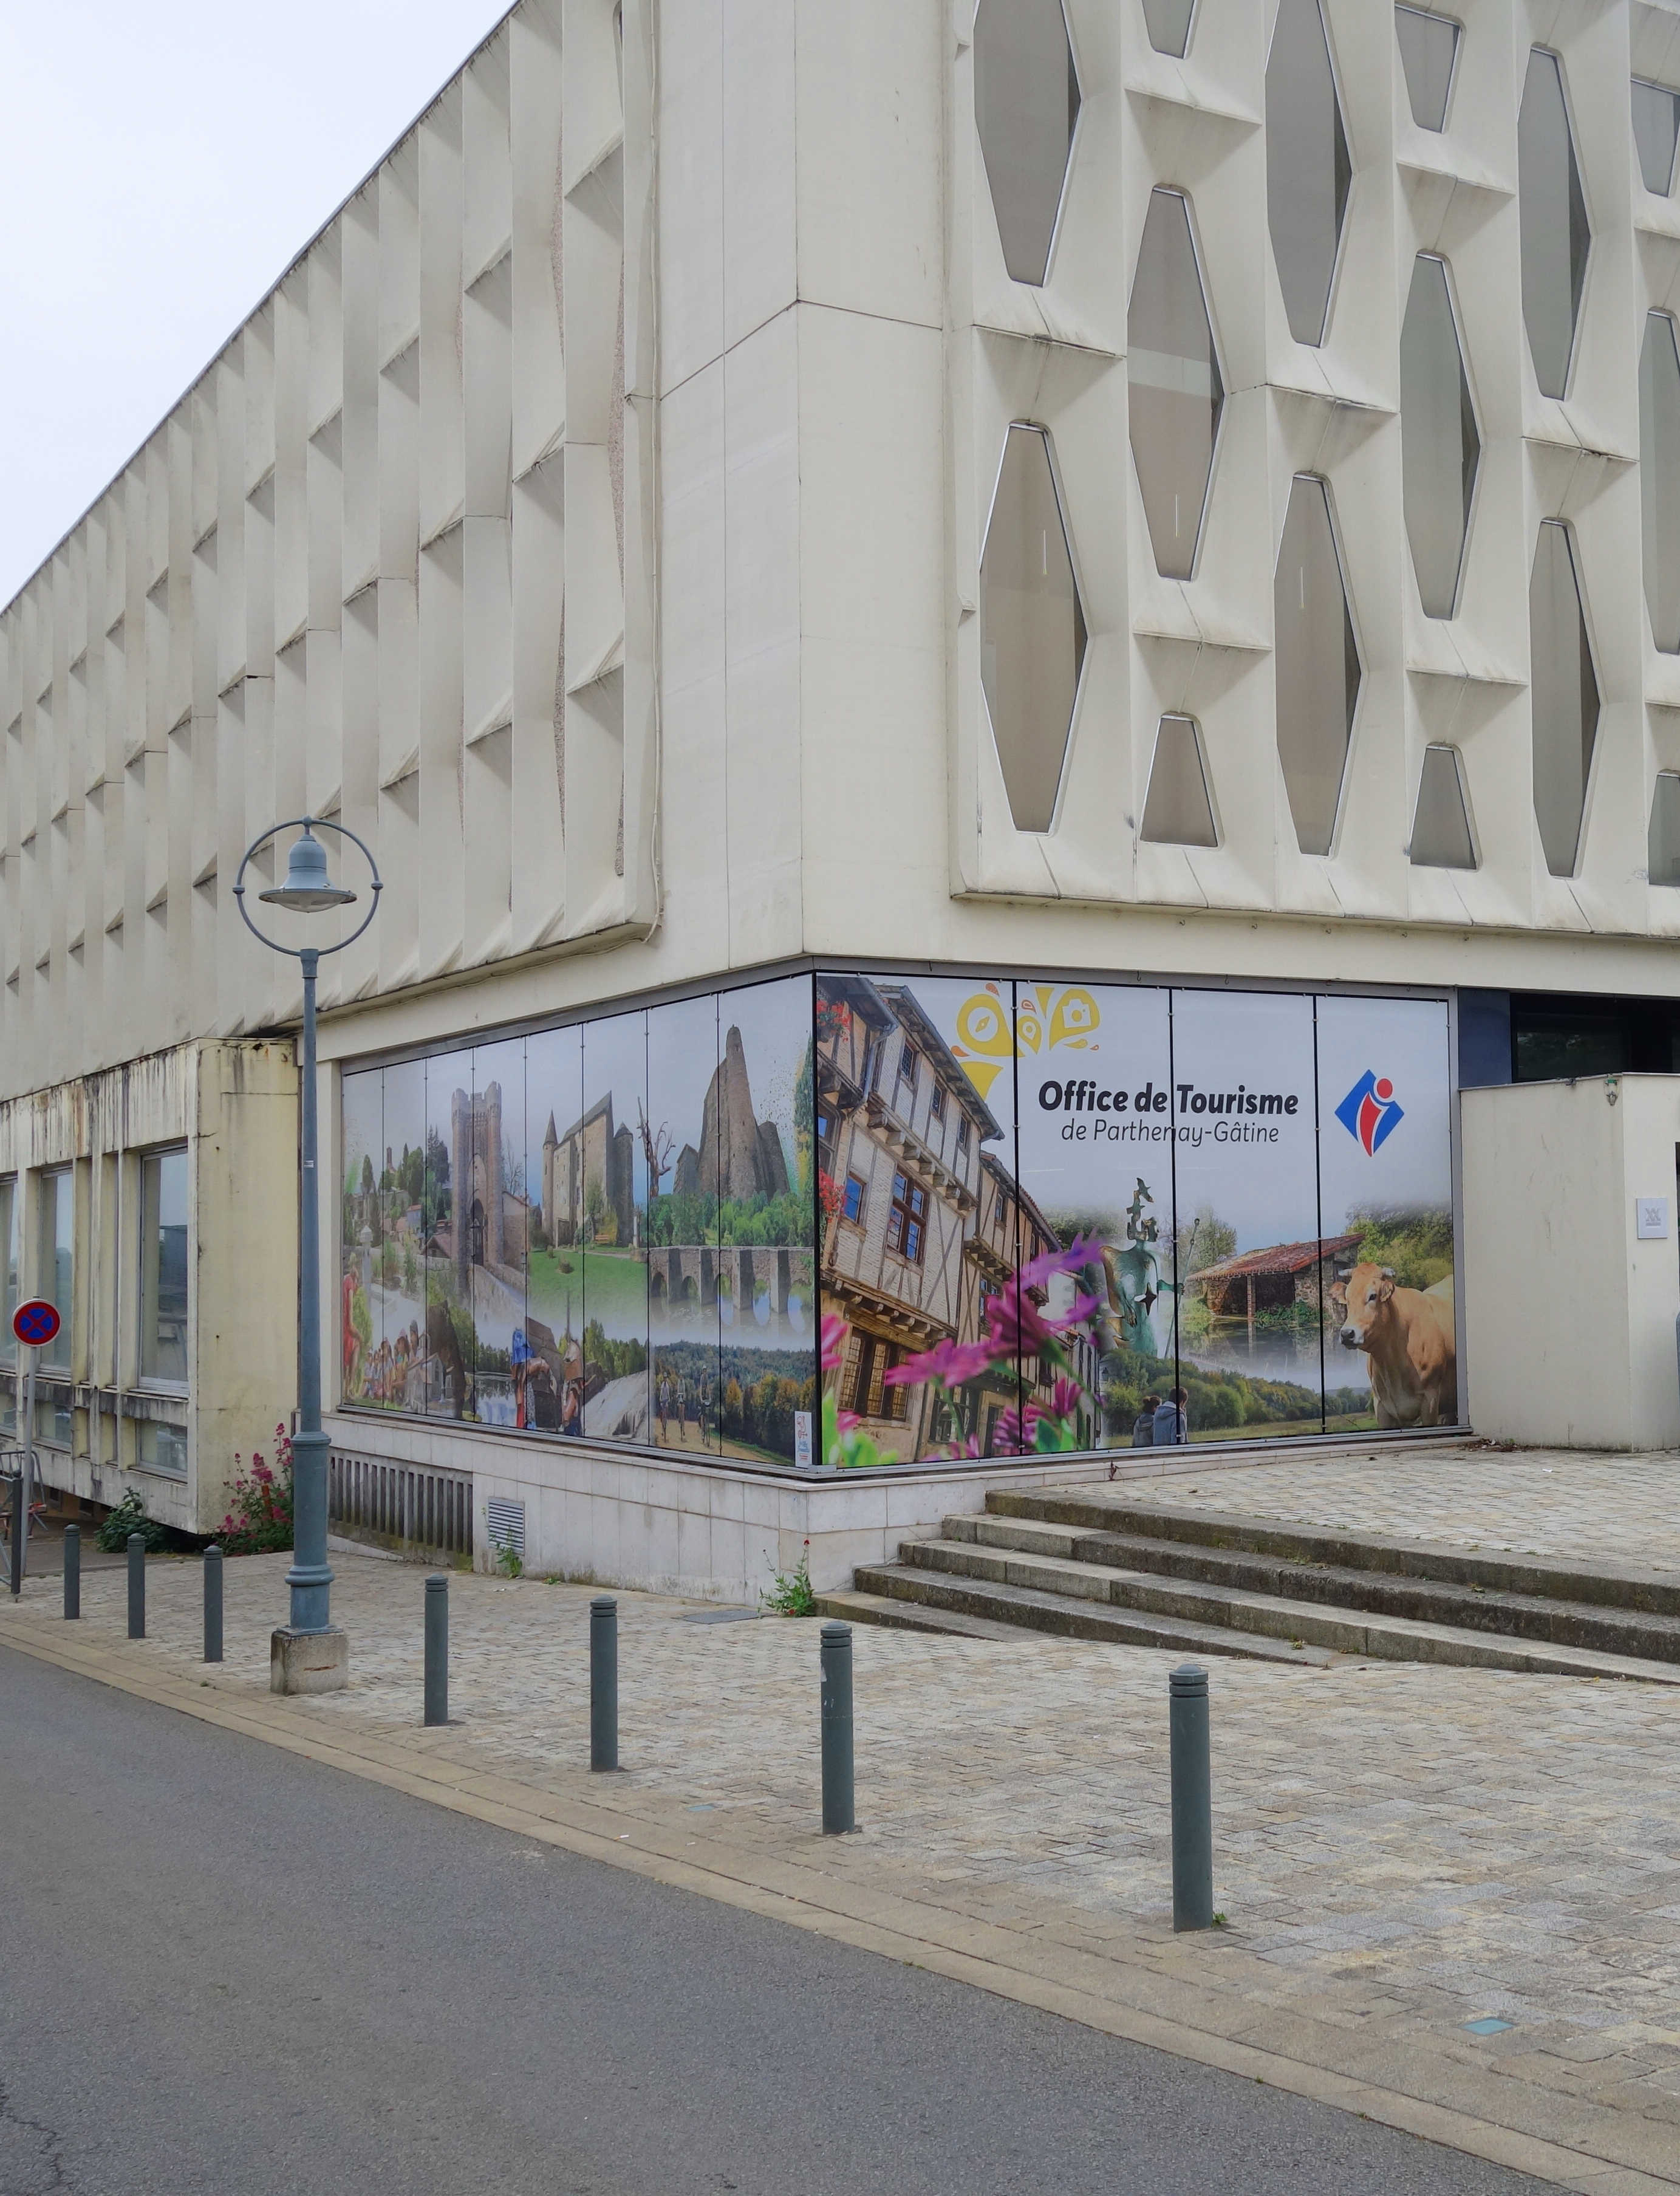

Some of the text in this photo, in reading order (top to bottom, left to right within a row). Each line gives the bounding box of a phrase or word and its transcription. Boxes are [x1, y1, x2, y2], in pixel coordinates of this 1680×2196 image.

[1039, 1080, 1299, 1115] Office de Tourisme
[1062, 1118, 1279, 1147] de Parthenay-Gâtine
